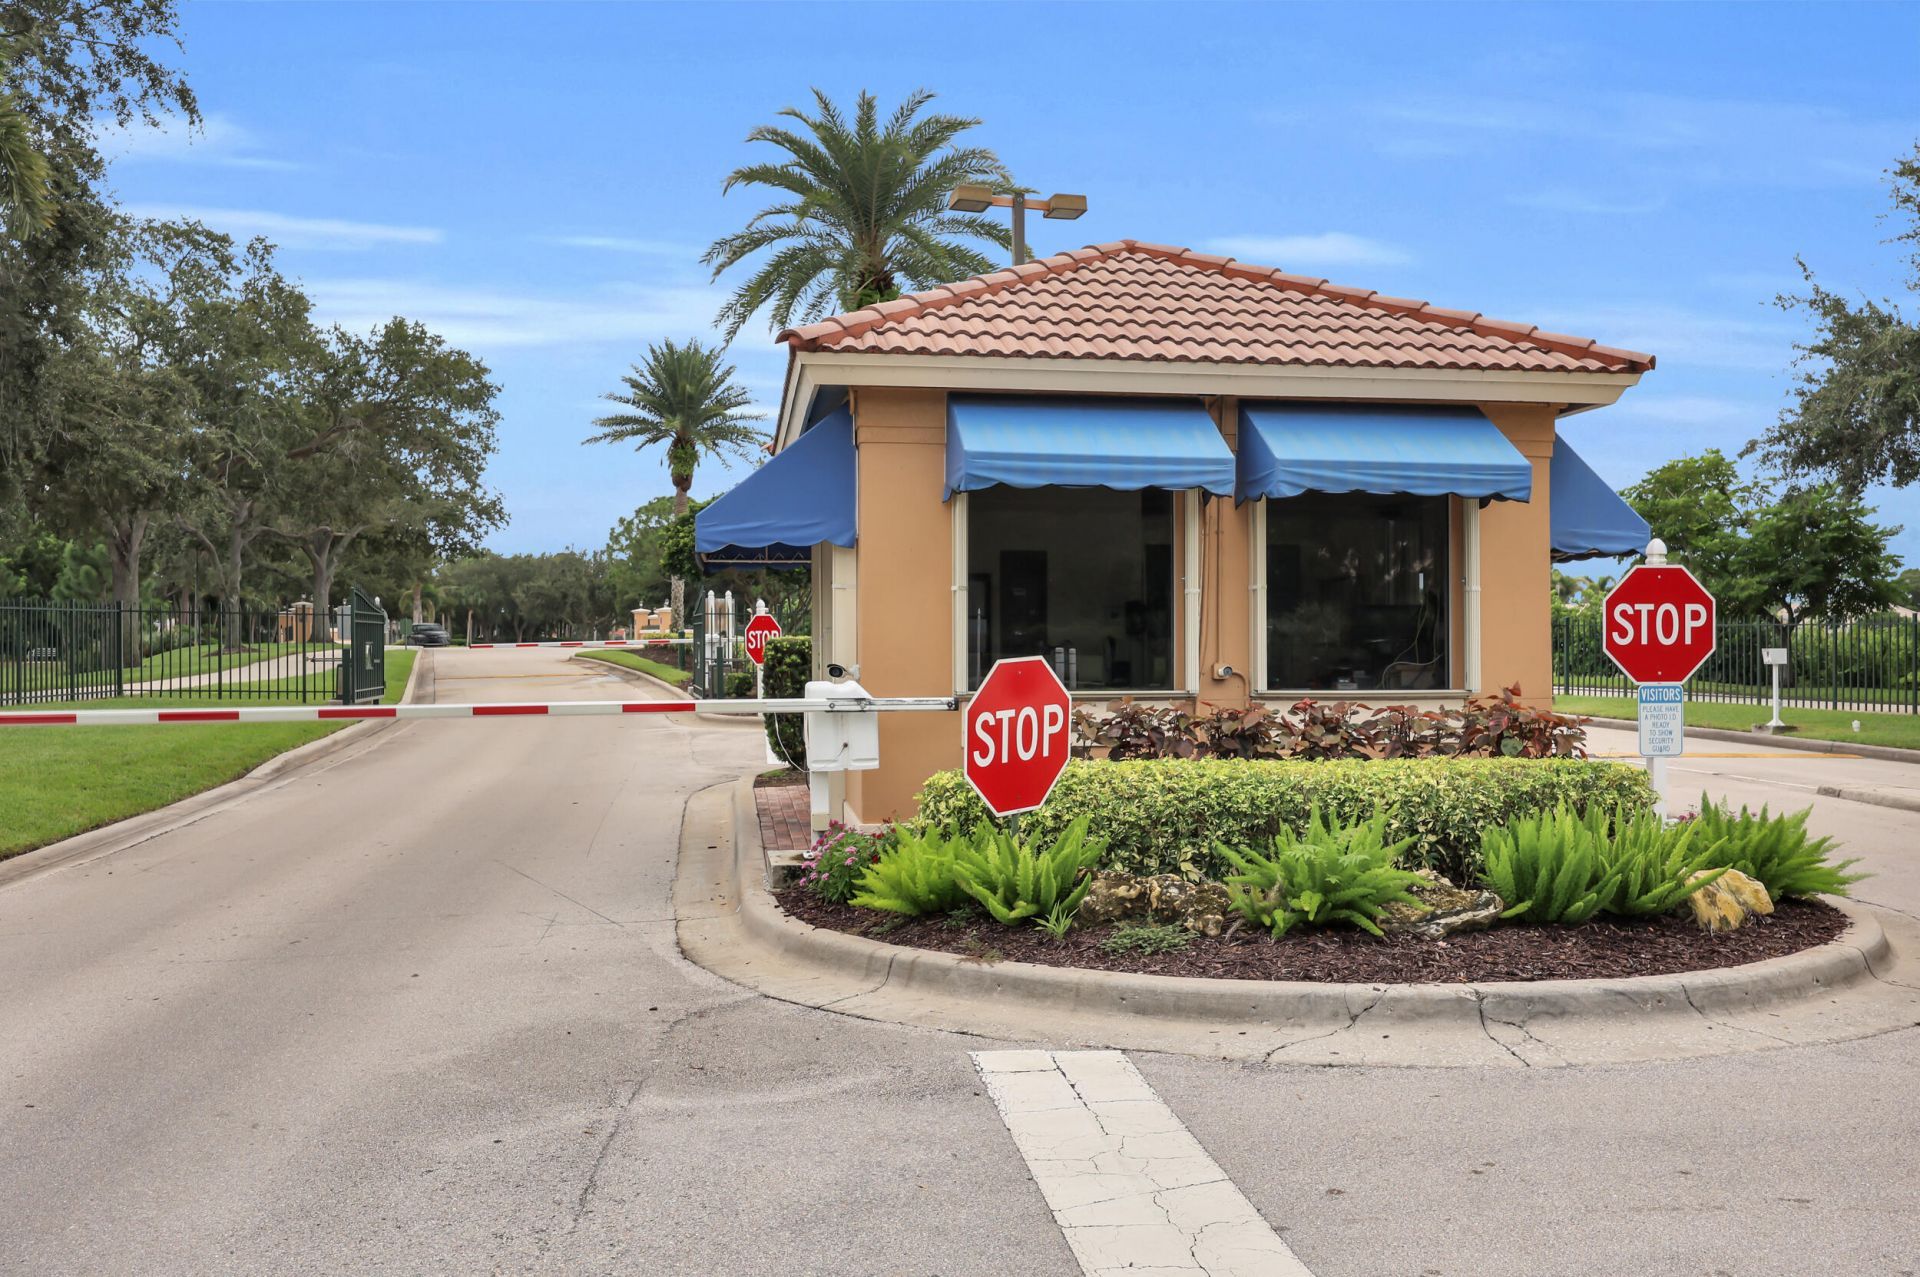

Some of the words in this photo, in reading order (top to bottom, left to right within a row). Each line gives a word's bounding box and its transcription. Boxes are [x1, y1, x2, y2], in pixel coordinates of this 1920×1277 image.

[1611, 602, 1708, 646] STOP
[1641, 688, 1681, 701] VISITORS
[1642, 705, 1663, 713] PLEASE
[1664, 705, 1680, 713] HAVE
[1650, 713, 1668, 721] PHOTO
[1652, 721, 1670, 729] READY
[973, 703, 1065, 768] STOP
[1649, 729, 1657, 737] TO
[1658, 729, 1673, 737] SHOW
[1648, 737, 1674, 745] SECURITY
[1652, 745, 1671, 753] GUARD
